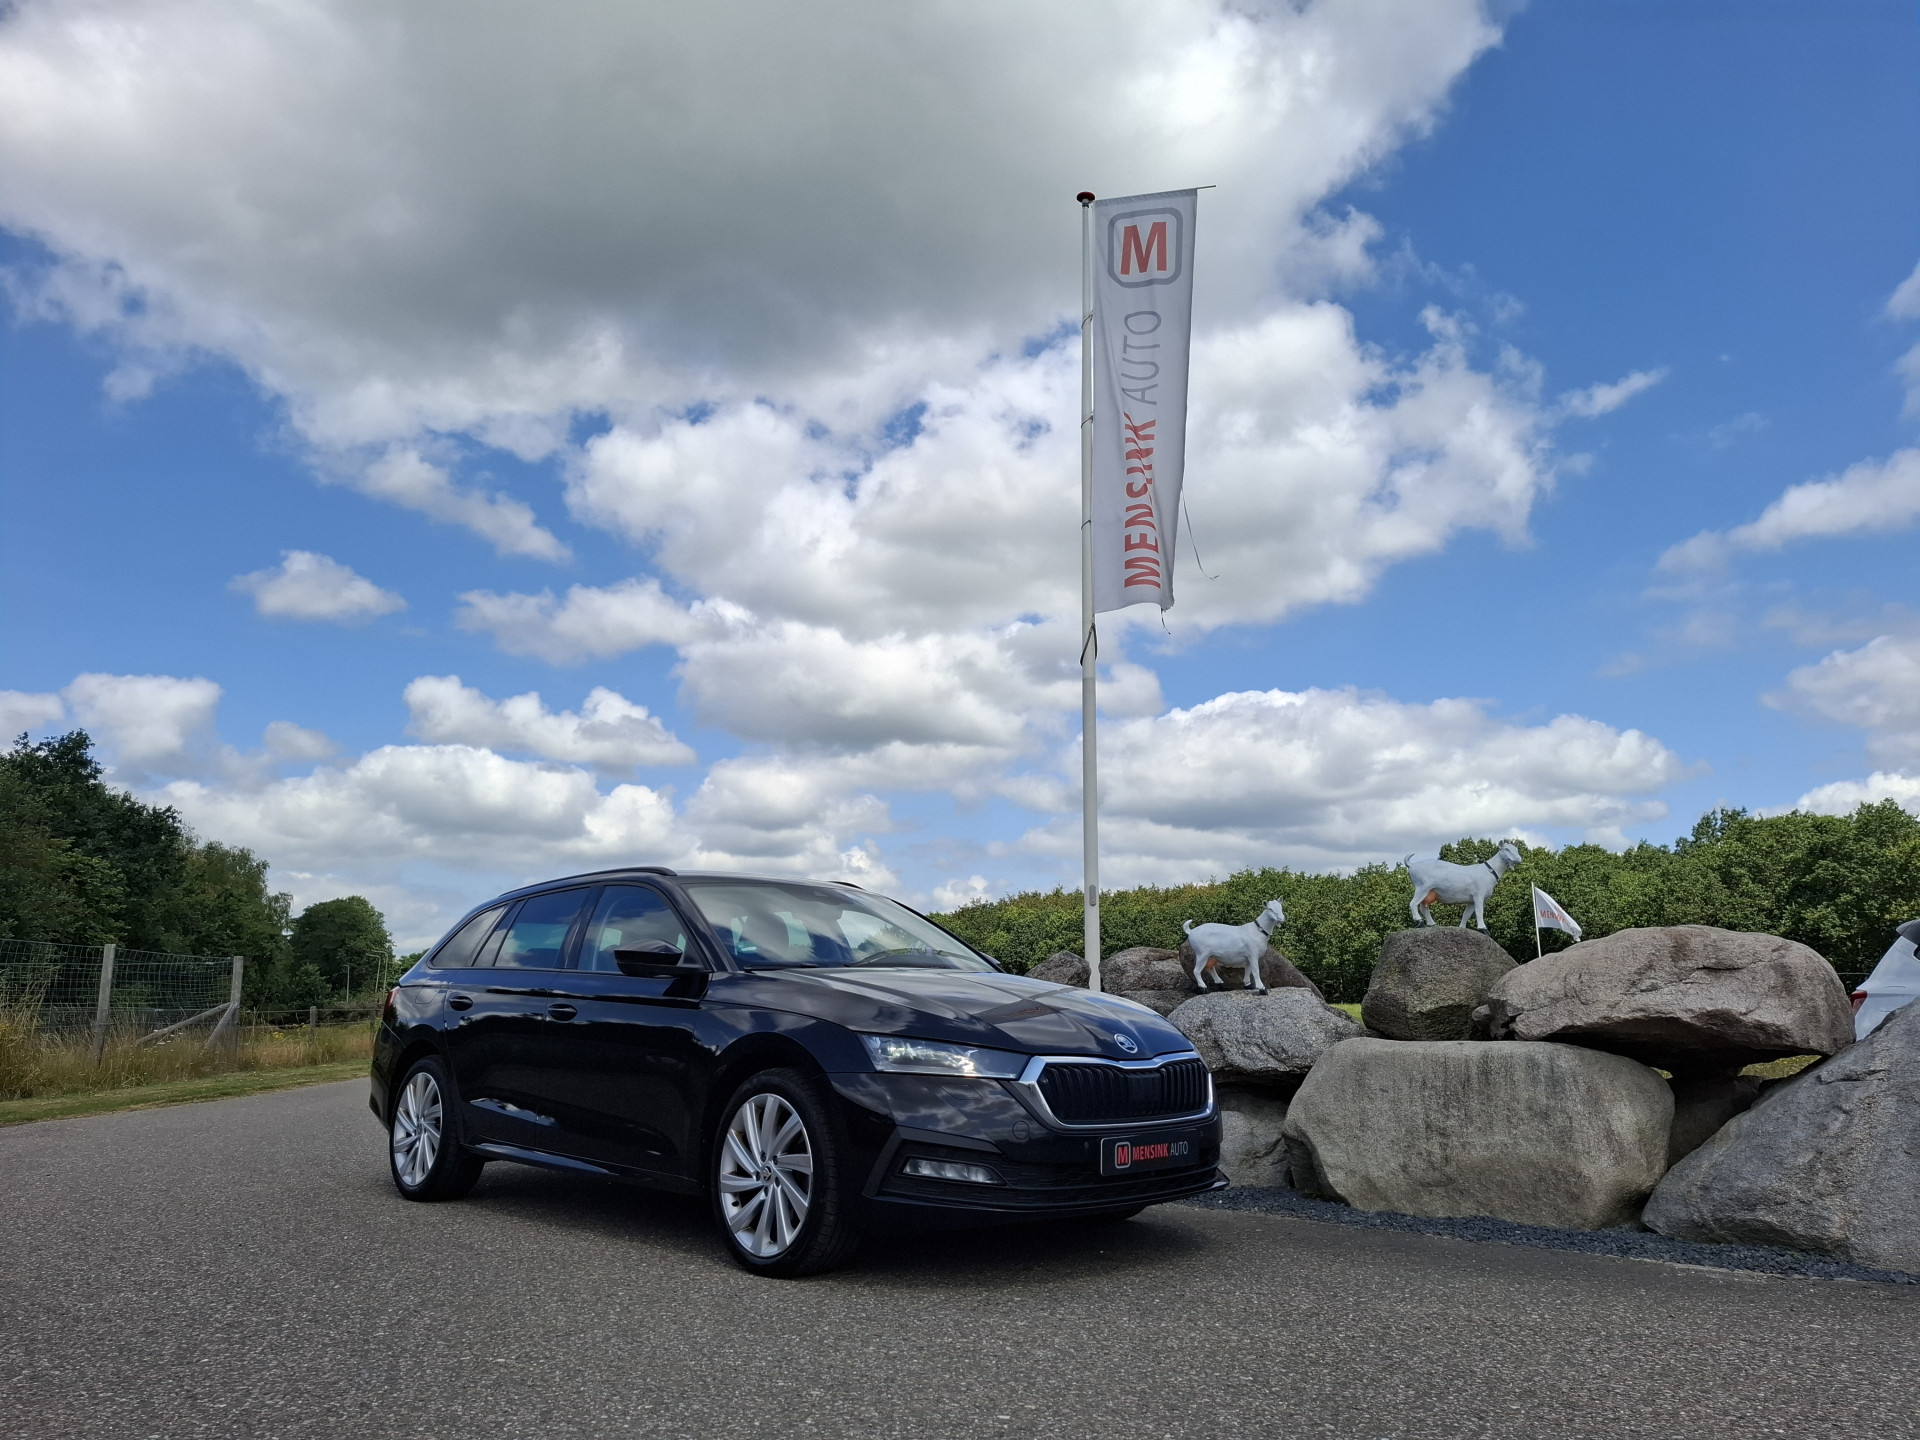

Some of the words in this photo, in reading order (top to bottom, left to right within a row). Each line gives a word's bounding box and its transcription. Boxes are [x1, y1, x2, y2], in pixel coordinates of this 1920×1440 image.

[1120, 221, 1167, 275] M
[1121, 310, 1162, 405] AUTO
[1123, 411, 1161, 589] MENSINK
[1117, 1145, 1129, 1165] M
[1132, 1143, 1169, 1161] MENSINK
[1170, 1140, 1189, 1156] AUTO
